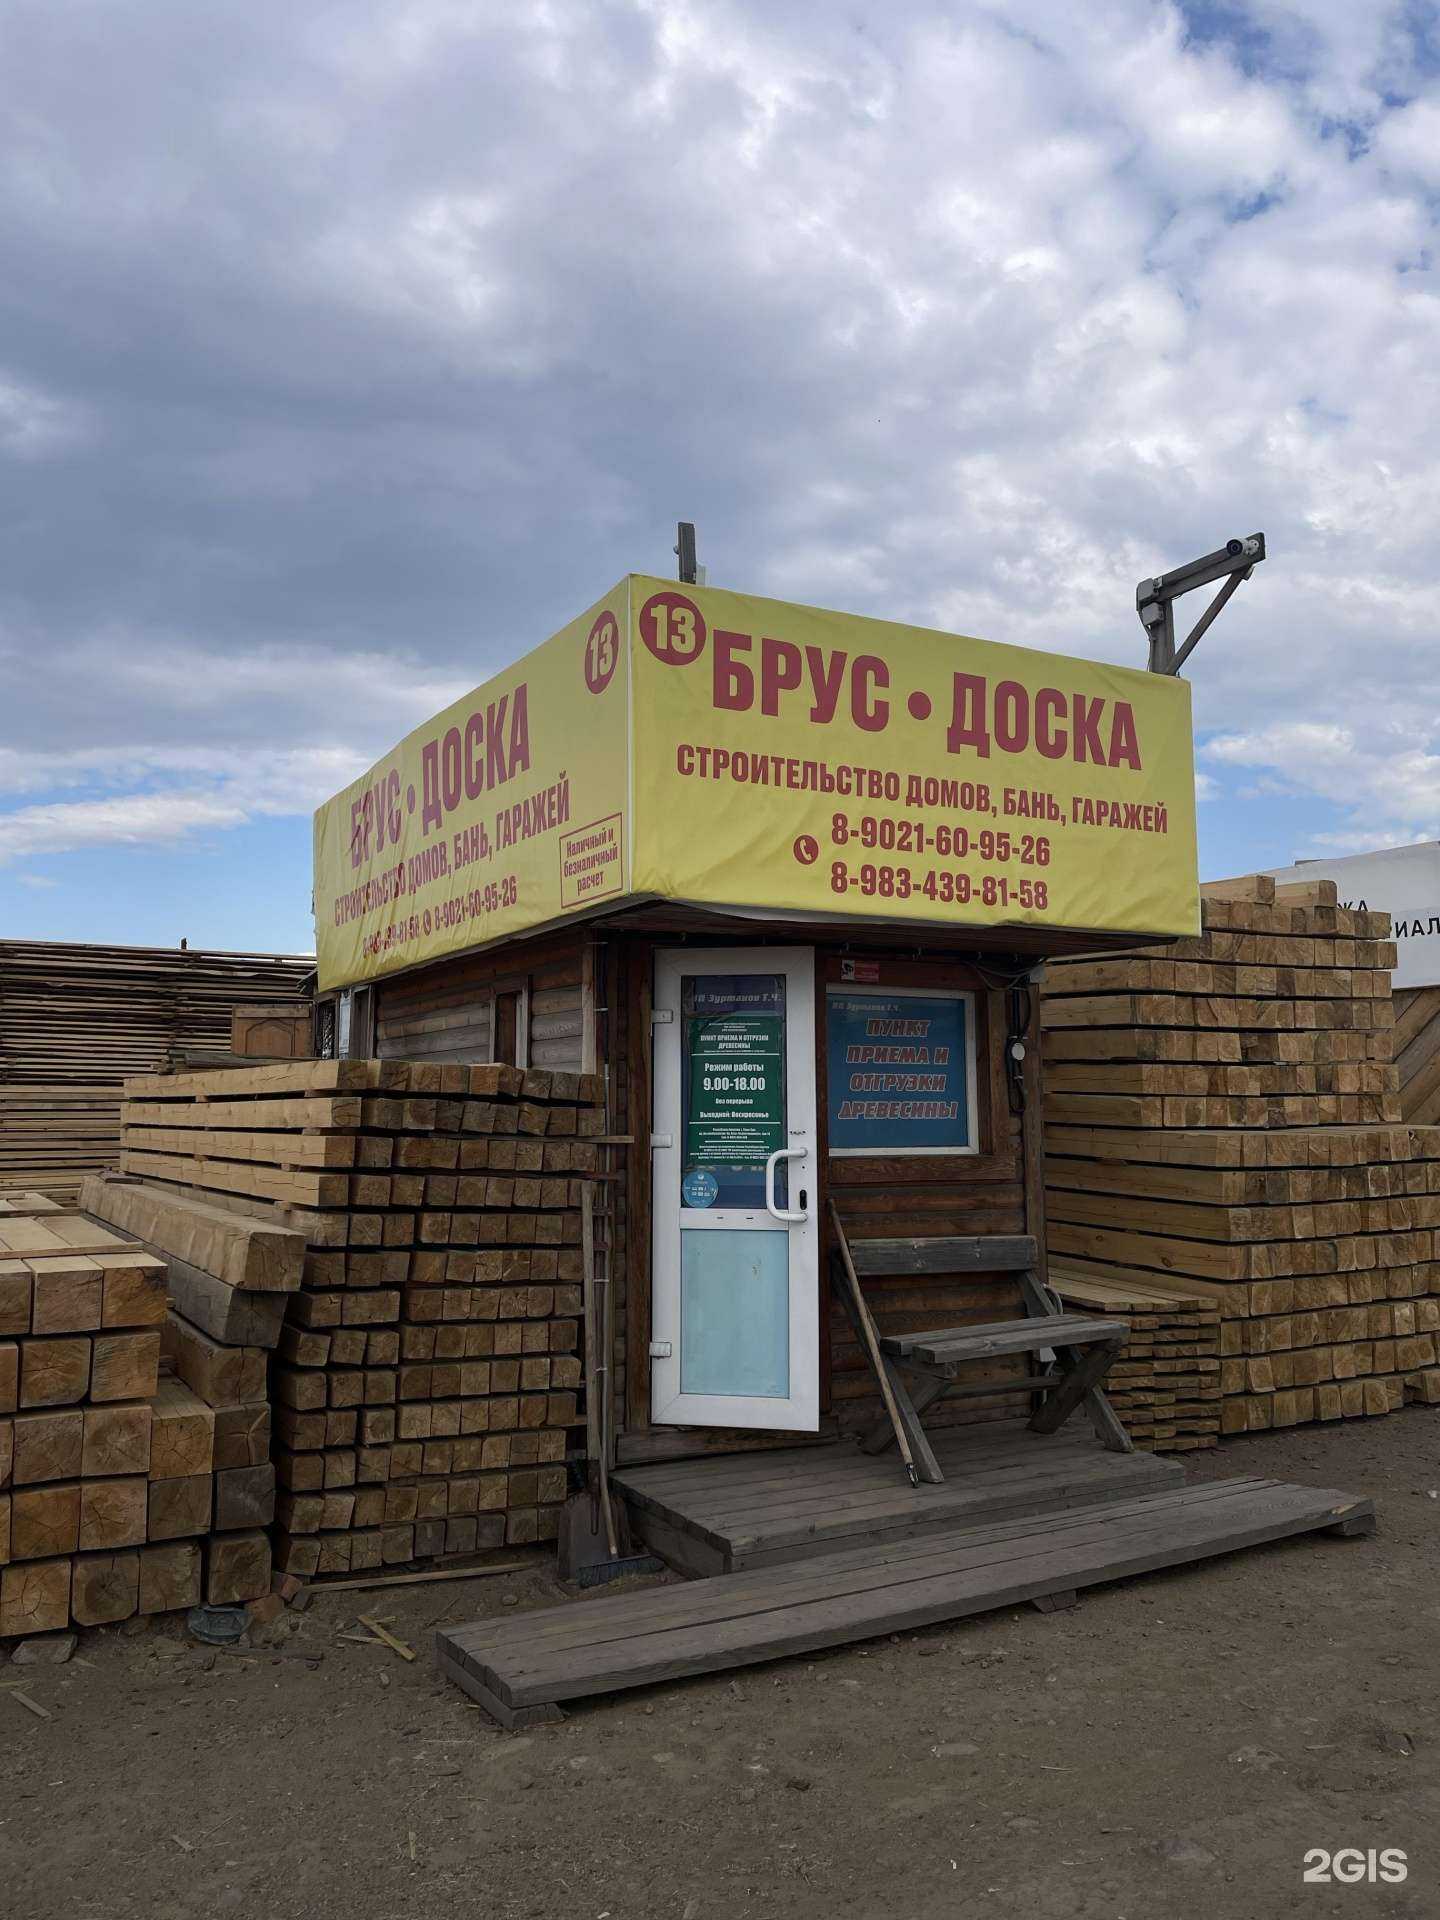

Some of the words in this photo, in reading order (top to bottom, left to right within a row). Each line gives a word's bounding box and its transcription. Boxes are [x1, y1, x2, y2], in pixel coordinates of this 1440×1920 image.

[651, 604, 696, 654] 13
[590, 622, 615, 683] 13
[713, 629, 890, 732] БРУС
[947, 671, 1142, 770] ДОСКА
[422, 683, 530, 836] ДОСКА
[677, 744, 900, 801] СТРОИТЕЛЬСТВО
[906, 775, 998, 818] ДОМОВ,
[1003, 787, 1067, 826] БАНЬ,
[1072, 797, 1168, 834] ГАРАЖЕЙ
[408, 841, 451, 896] ДОМОВ,
[453, 822, 493, 870] БАНЬ,
[496, 770, 570, 850] ГАРАЖЕЙ
[566, 827, 607, 858] Наличный
[608, 828, 614, 842] и
[831, 813, 1051, 866] 8-9021-60-95-26
[563, 843, 618, 878] безналичный
[434, 875, 517, 931] 8-9021-60-95-26
[577, 871, 605, 897] расчет
[831, 861, 1048, 910] 8-983-439-81-58
[866, 1018, 931, 1037] ПУНКТ
[704, 1063, 733, 1072] Режим
[733, 1063, 764, 1072] работы
[847, 1046, 930, 1064] ПРИЕМА
[934, 1047, 949, 1065] И
[703, 1077, 766, 1091] 9.00-18.00
[849, 1073, 947, 1092] ОТГРУЗКИ
[838, 1101, 958, 1120] ДРЕВЕСИНЫ
